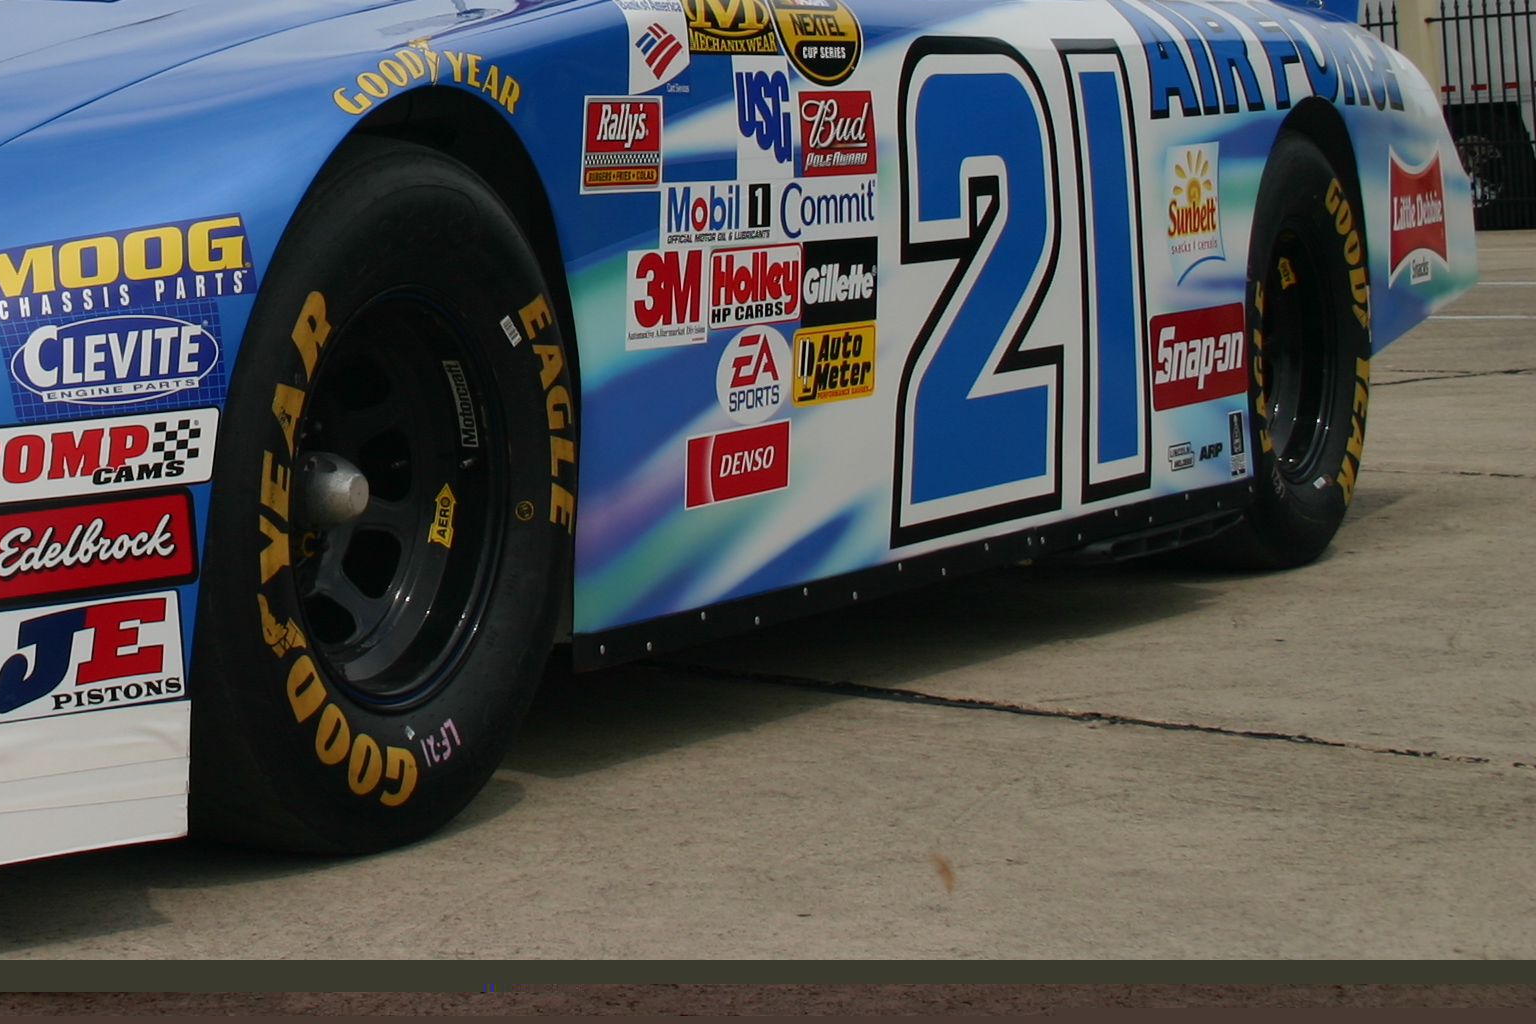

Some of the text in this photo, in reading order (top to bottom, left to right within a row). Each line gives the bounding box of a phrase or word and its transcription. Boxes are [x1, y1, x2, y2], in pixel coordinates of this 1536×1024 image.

[690, 29, 778, 52] MECHANIX WEAR
[789, 13, 848, 37] NEXTEL
[802, 45, 847, 59] CUP SERIES
[596, 103, 647, 149] Rally's
[735, 70, 792, 163] USG
[801, 98, 870, 148] Bud
[636, 170, 654, 181] COLAS
[667, 184, 740, 233] Mobil
[779, 179, 875, 239] Commit
[1167, 198, 1217, 237] Sunbelt
[1393, 194, 1416, 231] Little
[667, 233, 693, 244] OFFICIAL
[154, 270, 244, 302] PARTS
[634, 249, 703, 328] 3M
[713, 251, 800, 315] Holley
[803, 262, 875, 305] Gillette
[890, 35, 1151, 551] 21
[712, 301, 784, 323] HP CARBS
[23, 324, 203, 388] CLEVITE
[730, 333, 779, 389] EA
[817, 331, 863, 363] Auto
[1155, 325, 1244, 390] Snap-on
[46, 378, 197, 401] ENGINE PARTS
[815, 360, 872, 391] Meter
[444, 361, 478, 447] Motorcraft
[517, 292, 575, 536] EAGLE
[729, 384, 780, 413] SPORTS
[719, 445, 775, 478] DENSO
[1199, 442, 1223, 461] ARP
[90, 459, 185, 486] CAMS
[436, 496, 453, 540] AERO
[51, 676, 183, 712] PISTONS
